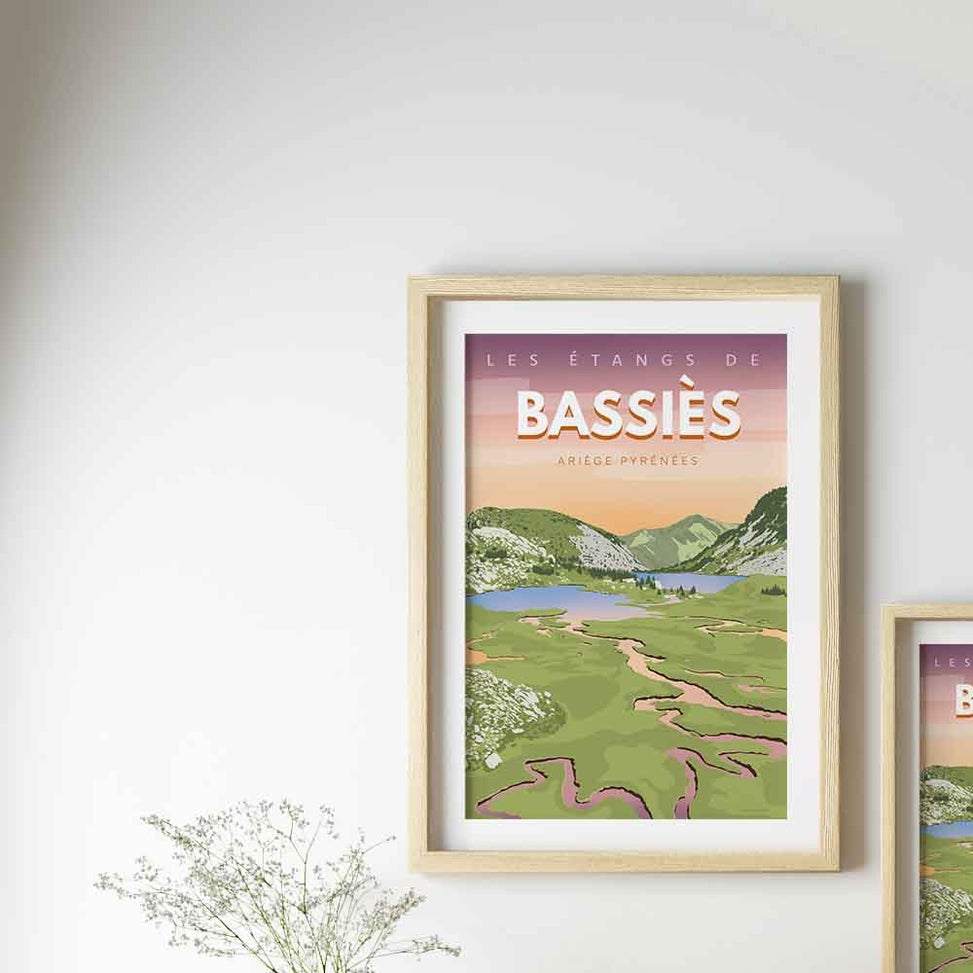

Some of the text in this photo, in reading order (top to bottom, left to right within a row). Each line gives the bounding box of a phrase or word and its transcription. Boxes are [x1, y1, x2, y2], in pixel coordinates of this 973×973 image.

[487, 350, 760, 367] LES ÉTANGS DE
[517, 373, 742, 440] BASSIÈS
[934, 658, 972, 668] LES
